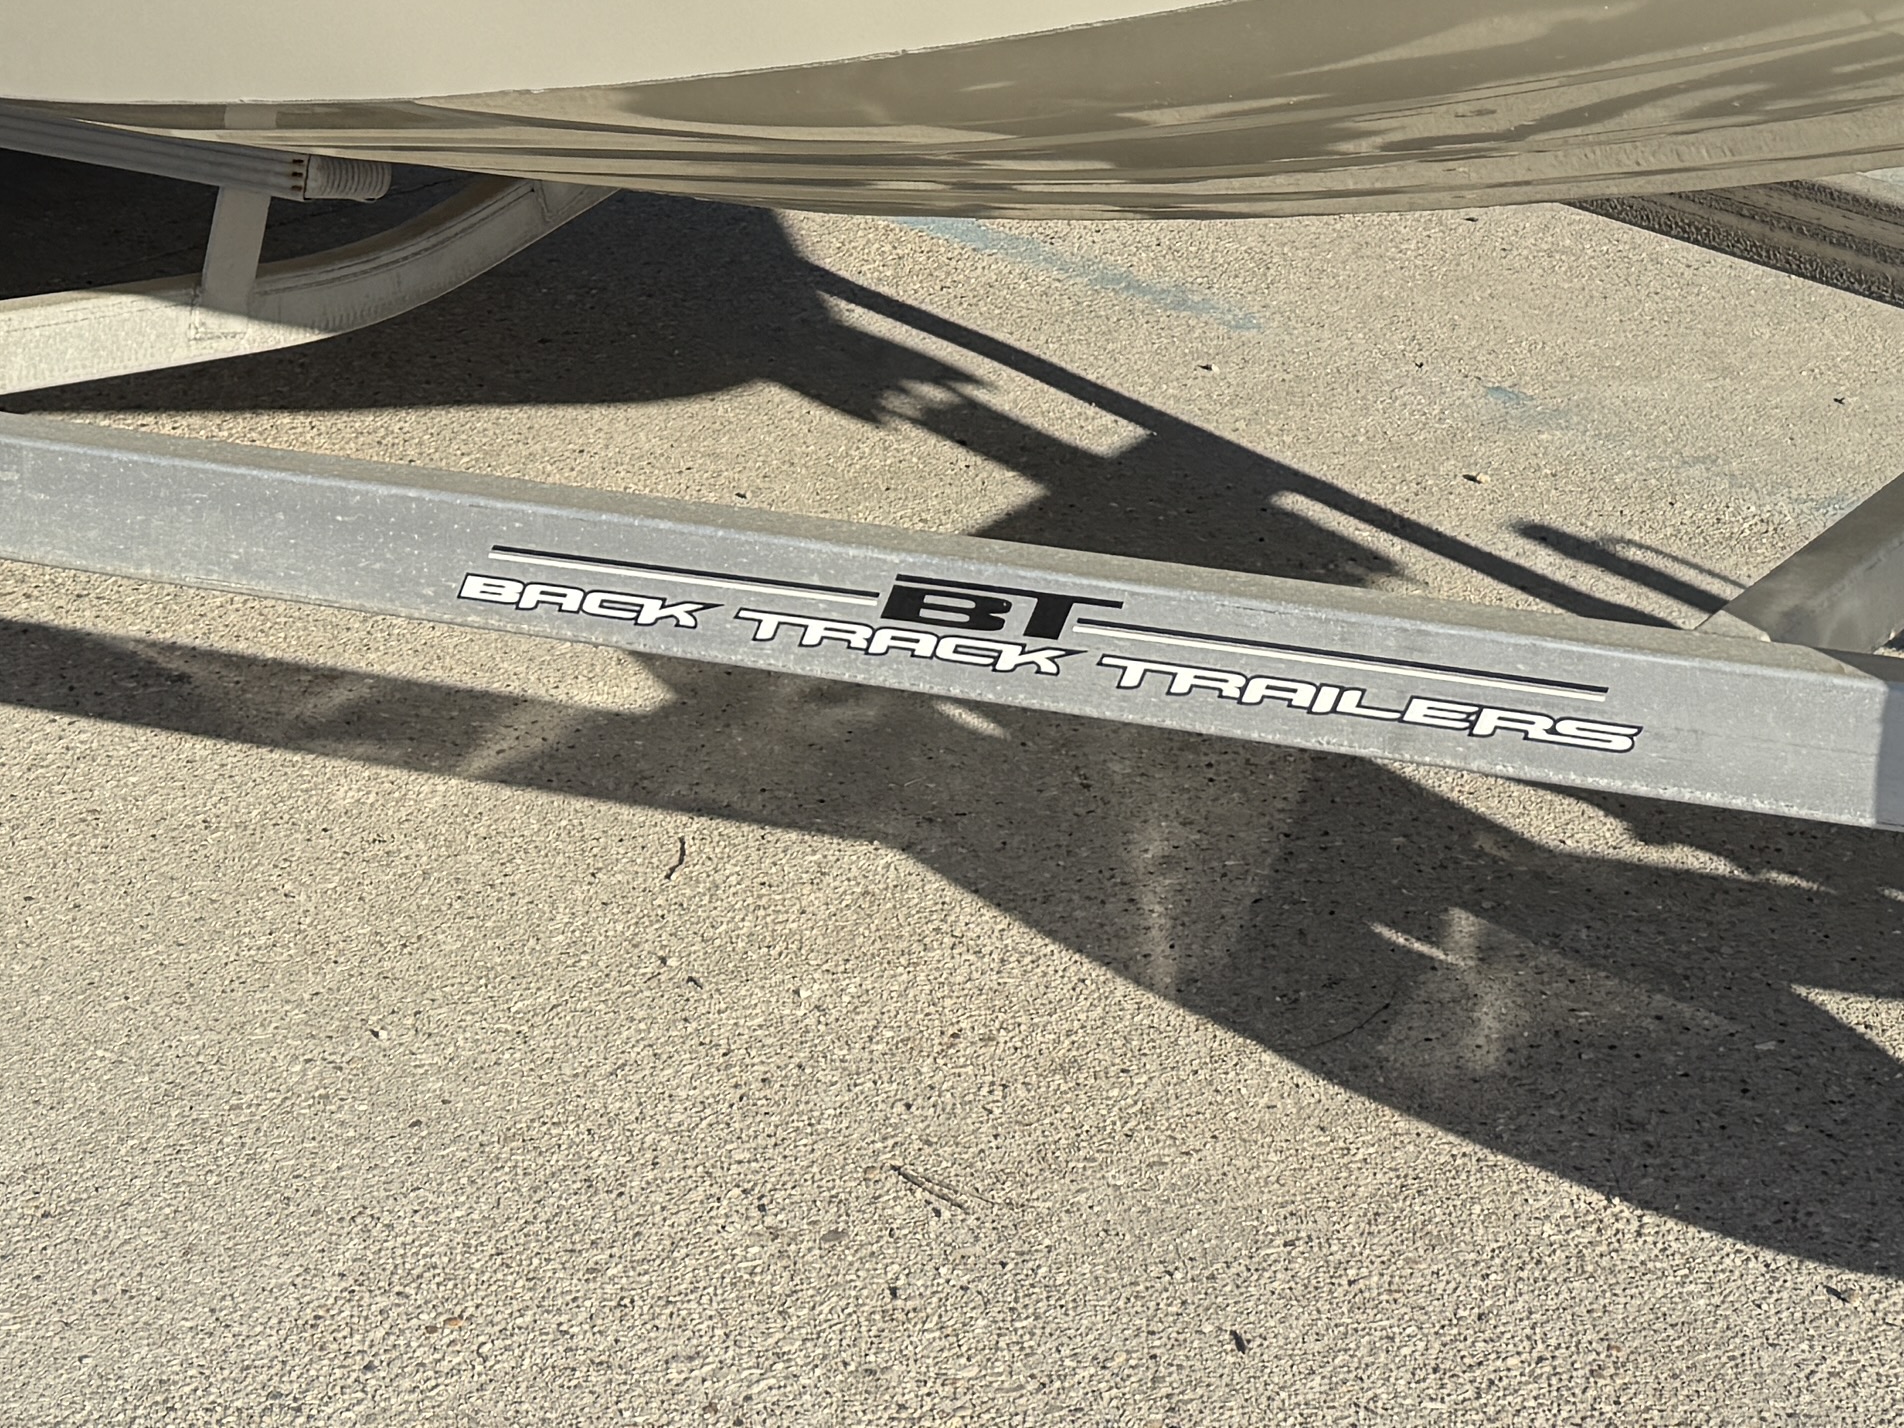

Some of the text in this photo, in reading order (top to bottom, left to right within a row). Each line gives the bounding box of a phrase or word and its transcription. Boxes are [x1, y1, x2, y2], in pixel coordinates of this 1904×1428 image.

[458, 572, 1644, 754] BACK TRACK TRAILERS
[878, 573, 1123, 642] BT
